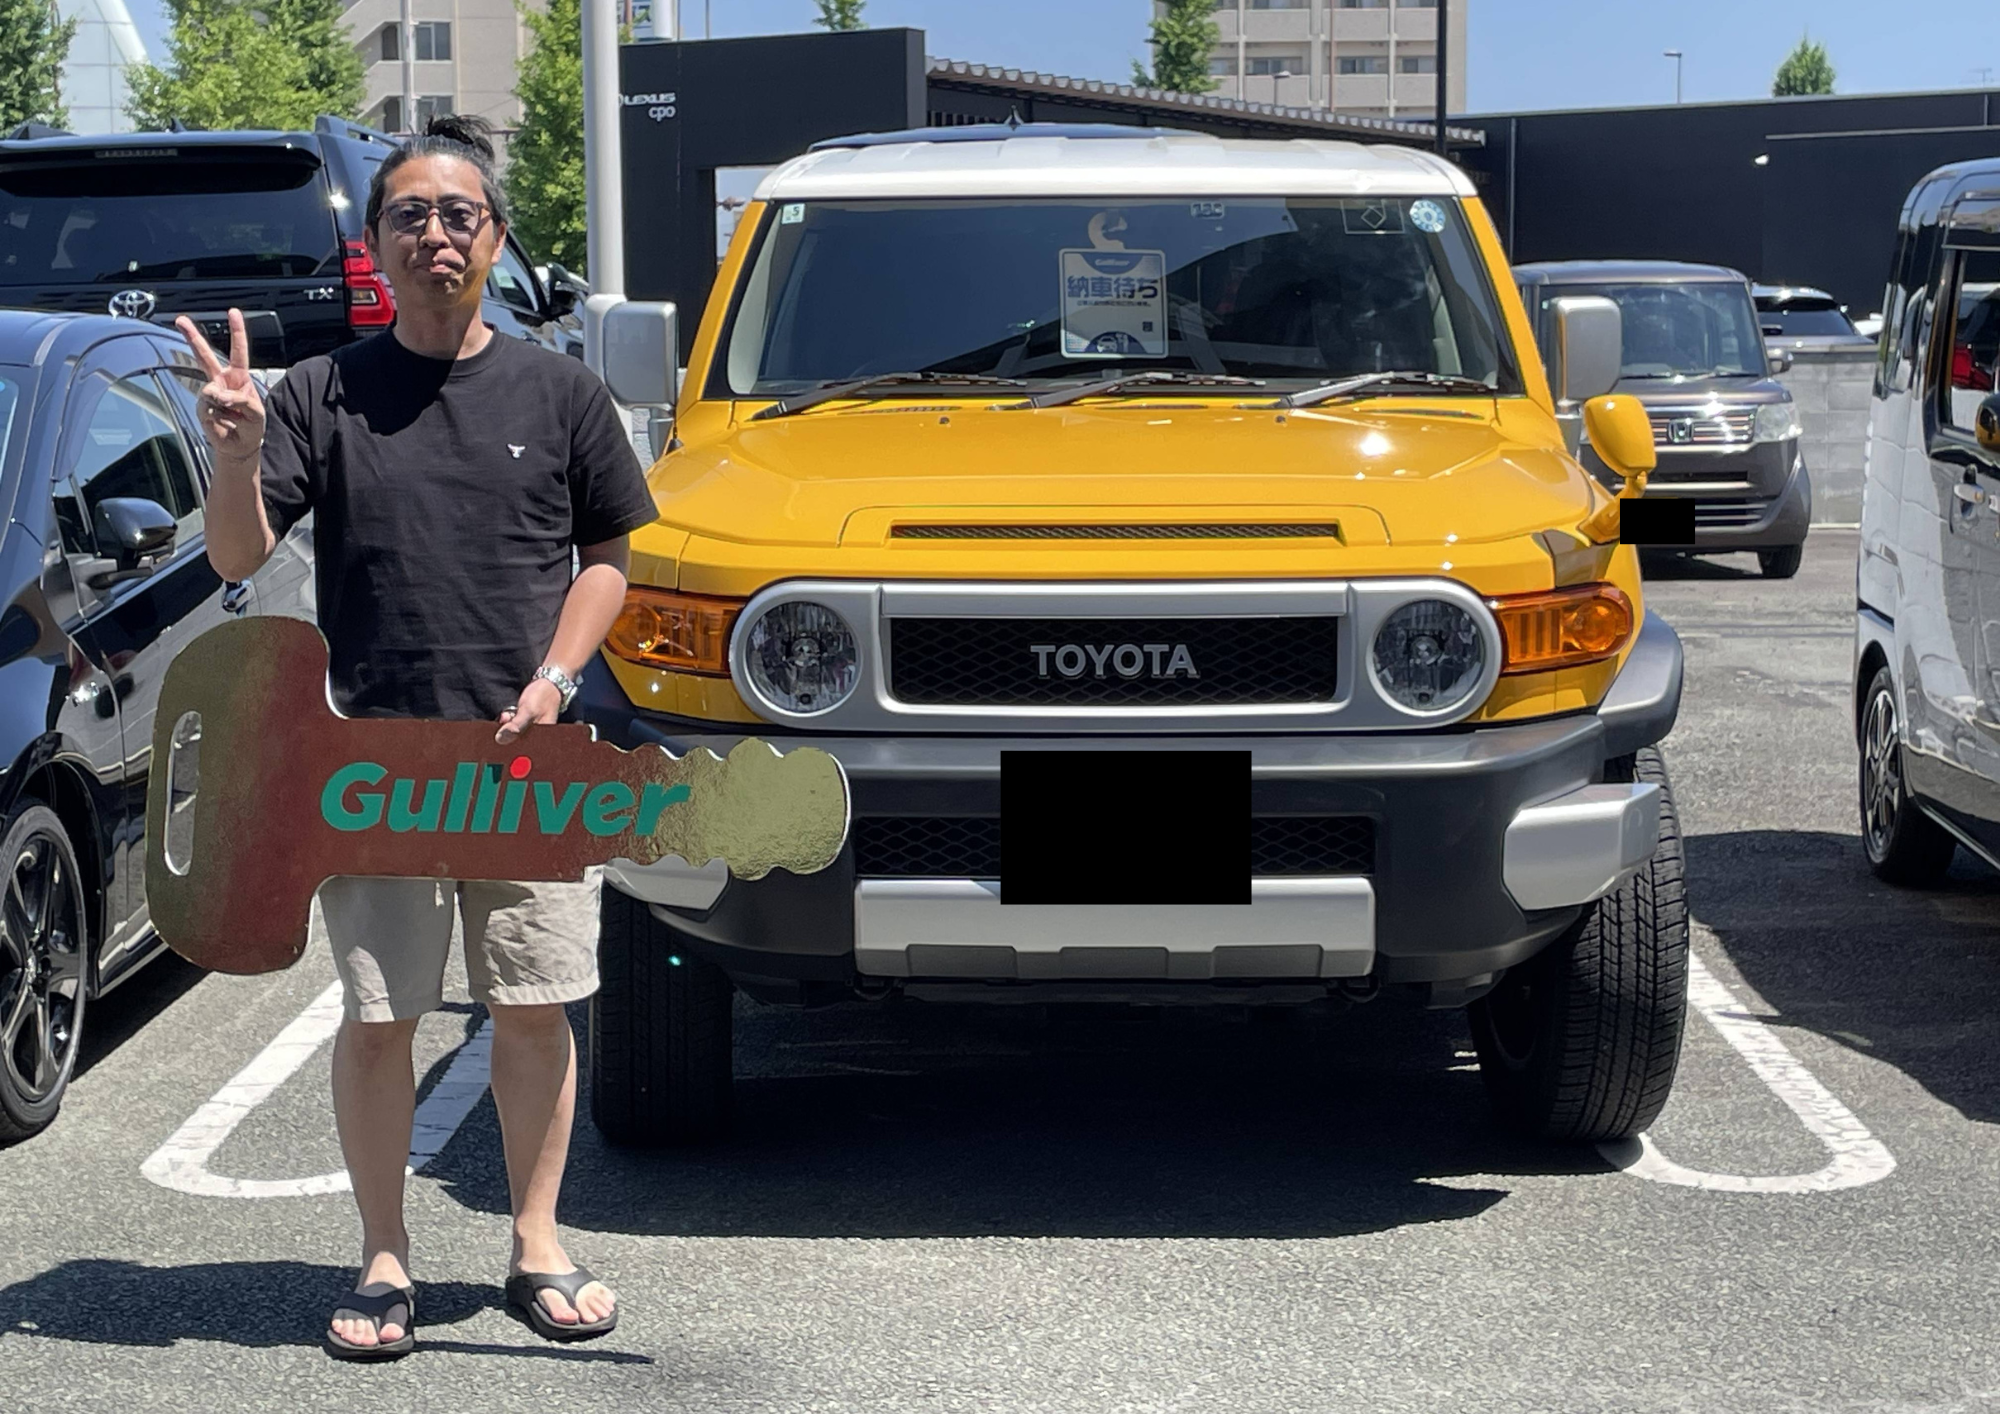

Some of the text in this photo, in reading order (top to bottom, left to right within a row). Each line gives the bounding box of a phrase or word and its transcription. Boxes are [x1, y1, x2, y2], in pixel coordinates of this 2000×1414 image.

[624, 92, 677, 106] LEXUS
[648, 106, 676, 122] cpo
[303, 287, 334, 300] TX
[1067, 275, 1159, 299] 納車待ち
[1030, 644, 1199, 678] TOYOTA
[320, 756, 691, 837] Gulliver
